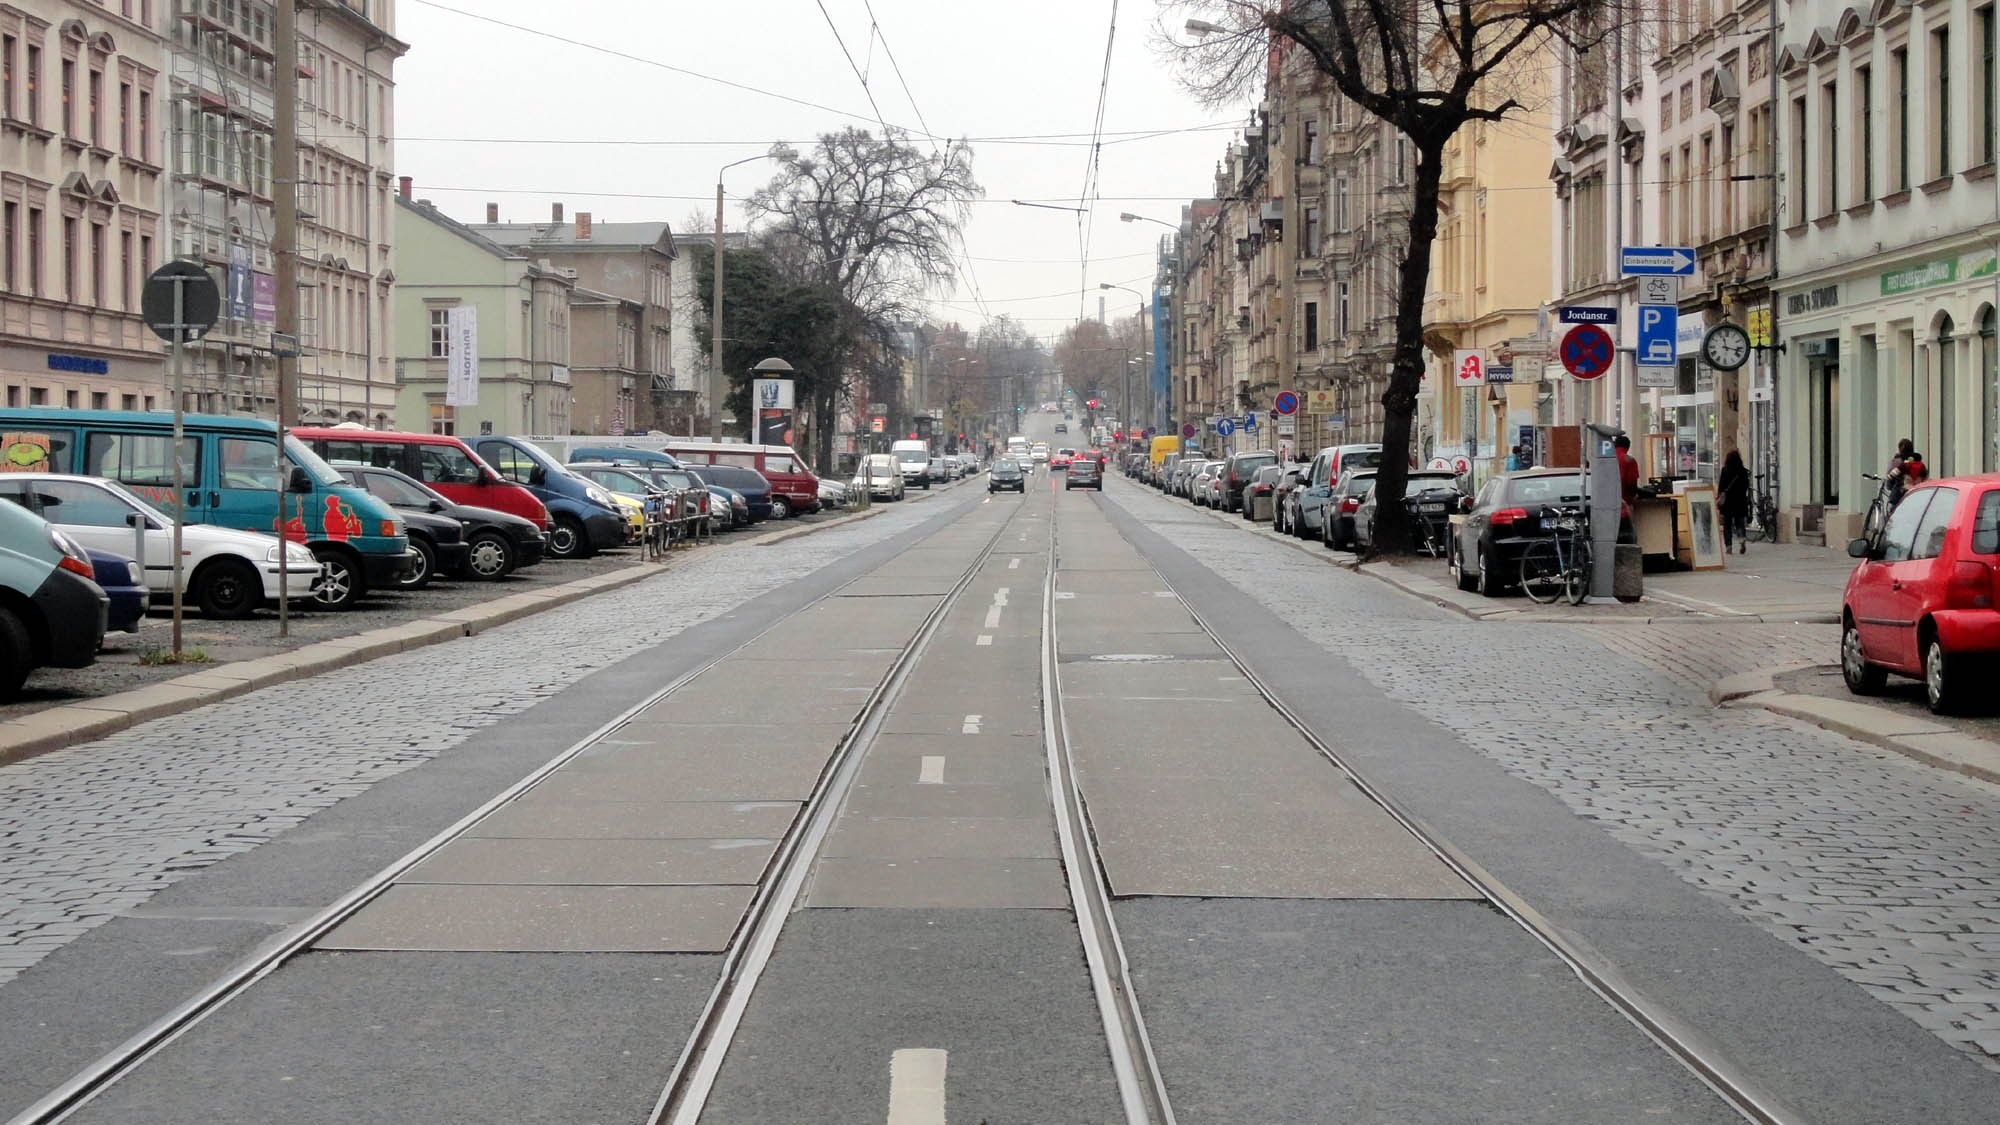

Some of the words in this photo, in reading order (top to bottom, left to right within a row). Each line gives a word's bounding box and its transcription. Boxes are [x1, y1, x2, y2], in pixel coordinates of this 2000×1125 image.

[1625, 257, 1675, 265] Einbahnstraße
[1567, 310, 1609, 321] Jordanstr.
[1643, 309, 1661, 332] P
[1602, 440, 1612, 456] P
